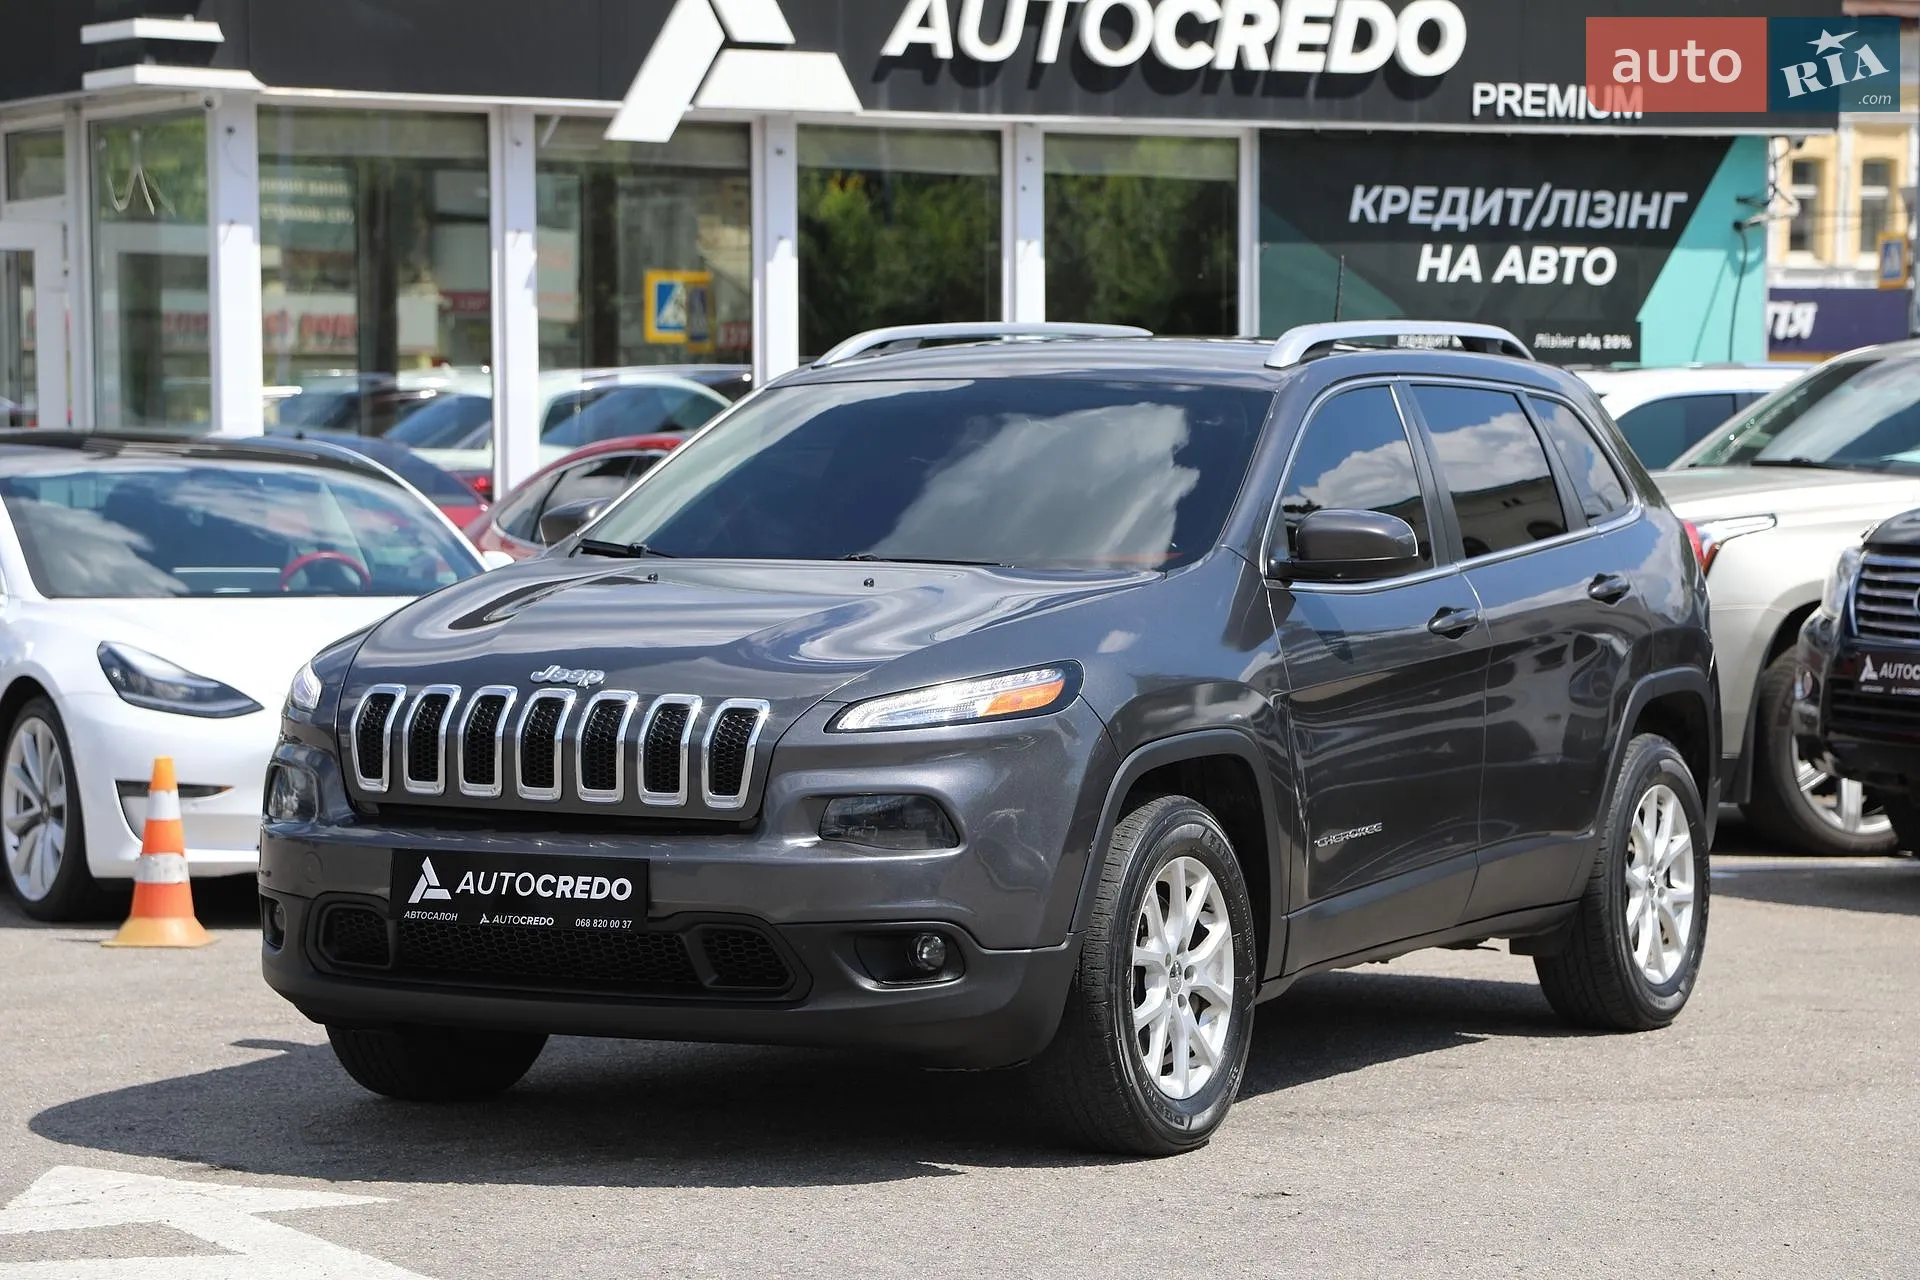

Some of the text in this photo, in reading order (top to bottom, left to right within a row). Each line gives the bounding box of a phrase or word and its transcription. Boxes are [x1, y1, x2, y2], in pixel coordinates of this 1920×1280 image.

[880, 0, 1467, 77] AUTOCREDO
[1472, 83, 1643, 119] PREMIUM
[1349, 182, 1688, 232] КРЕДИТ/ЛІЗІНГ
[1417, 244, 1618, 286] НА АВТО
[530, 665, 606, 687] Jeep
[1314, 822, 1383, 847] CHEROKEE
[455, 871, 633, 901] AUTOCREDO
[404, 910, 458, 922] АВТОСАЛОН
[492, 914, 555, 927] AUTOCREDO
[575, 918, 632, 930] 068 820 00 37
